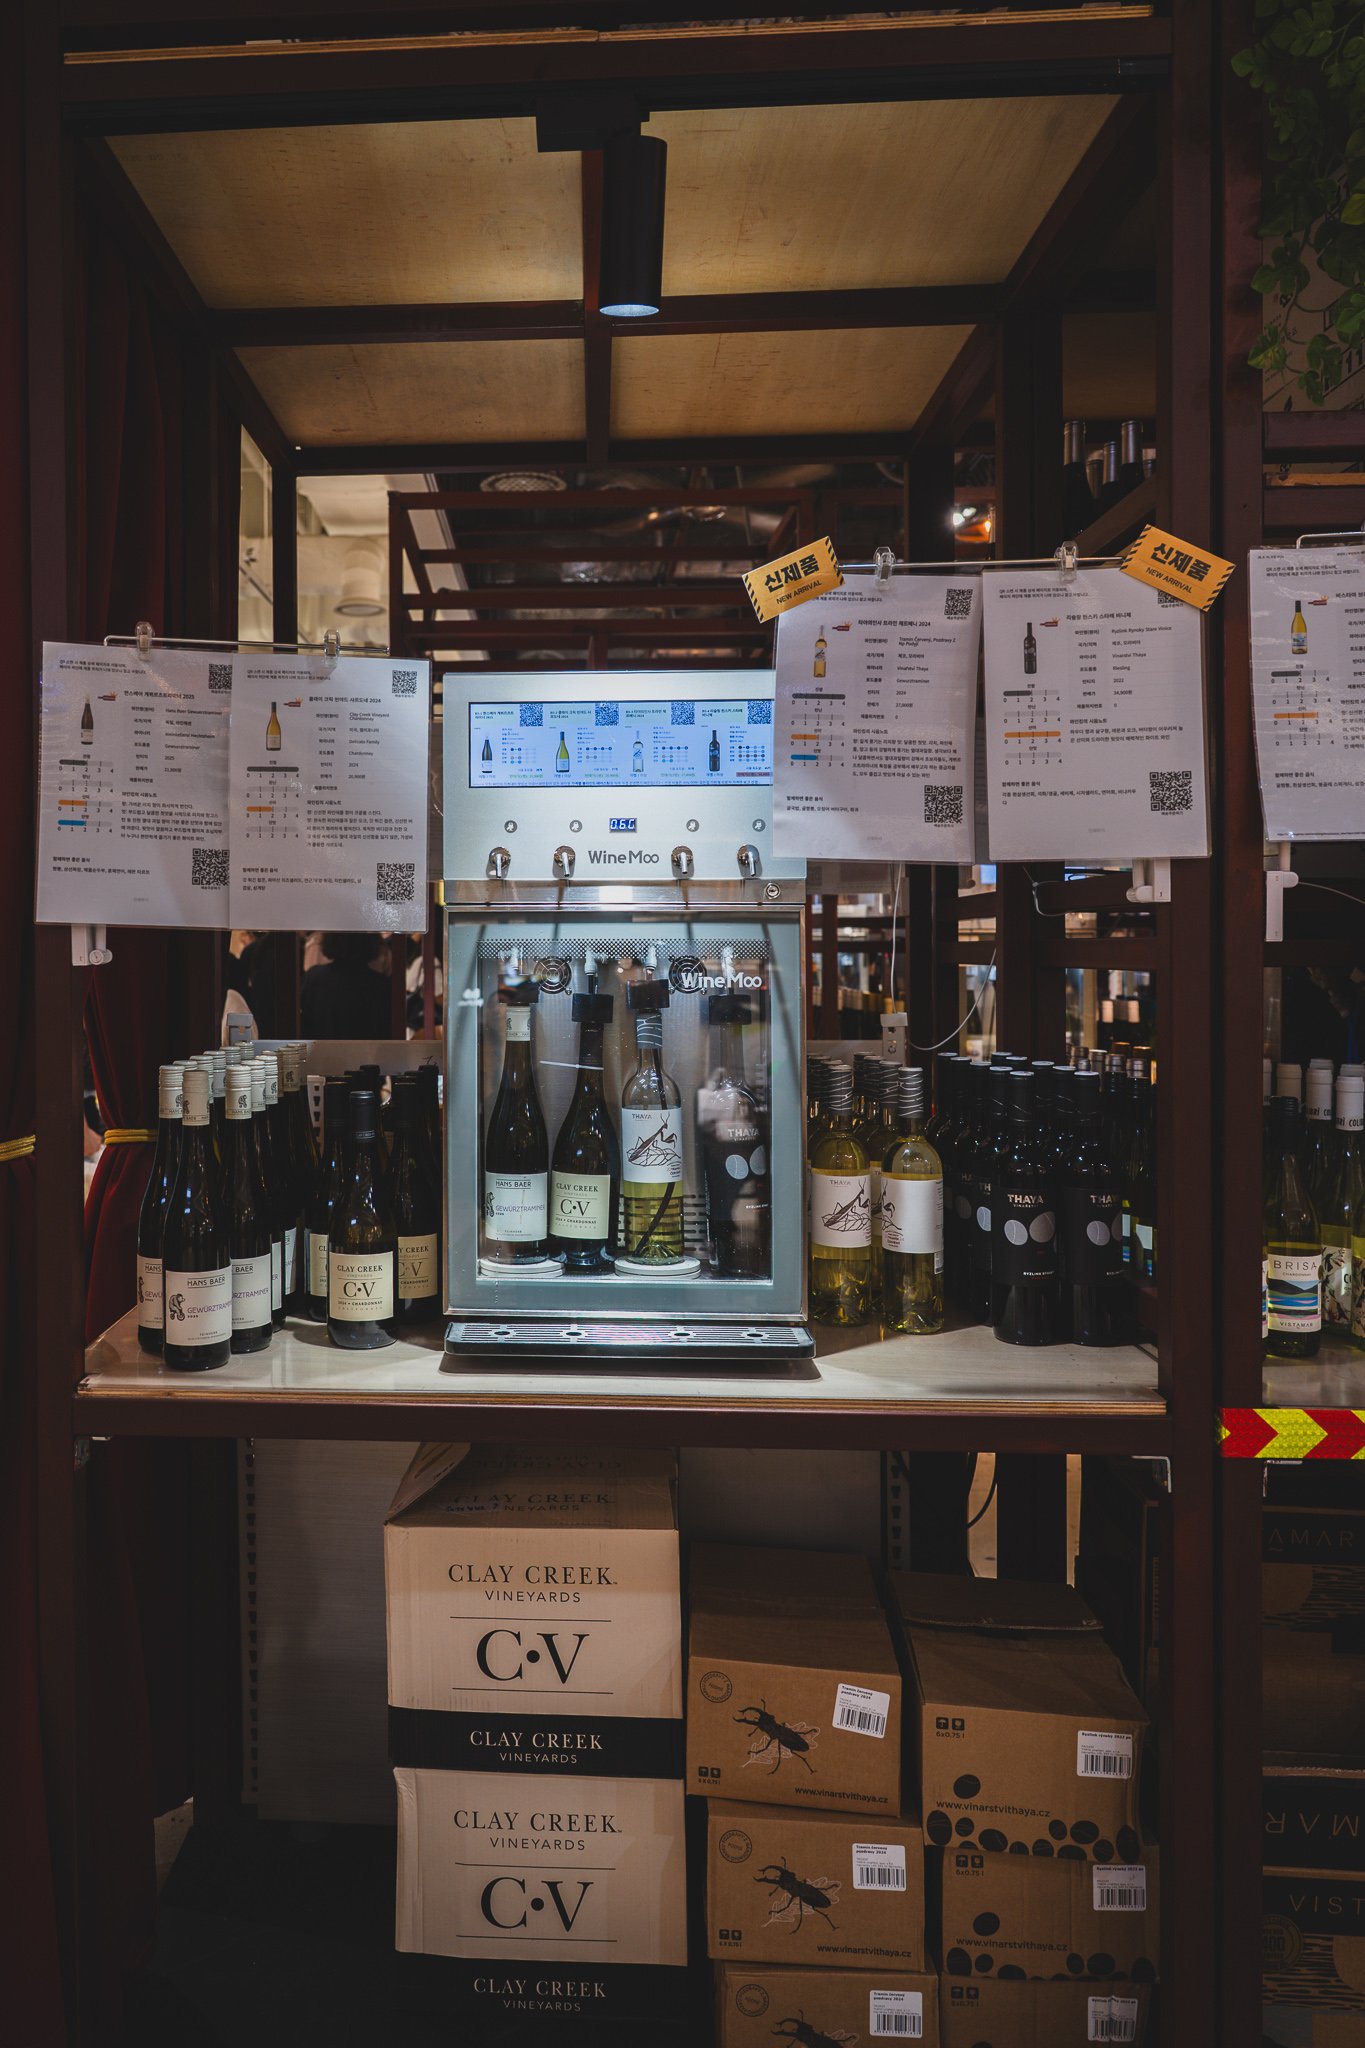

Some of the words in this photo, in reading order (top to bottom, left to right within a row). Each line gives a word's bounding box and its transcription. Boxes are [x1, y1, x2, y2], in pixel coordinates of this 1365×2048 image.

[1151, 543, 1212, 582] 신제품
[764, 554, 820, 592] 신제품
[1146, 567, 1164, 580] NEW
[1164, 574, 1193, 594] ARRIVAL
[776, 592, 793, 604] NEW
[792, 580, 823, 598] ARRIVAL
[728, 1128, 760, 1137] THAYA
[573, 1184, 599, 1192] CREEK
[1007, 1194, 1044, 1204] THAYA
[406, 1245, 429, 1253] CREEK
[337, 1265, 356, 1273] CLAY
[358, 1264, 383, 1273] CREEK
[1273, 1260, 1317, 1270] BRISA
[210, 1276, 226, 1285] BAER
[504, 1504, 580, 1512] NEYARDS
[448, 1563, 514, 1583] CLAY
[525, 1566, 613, 1586] CREEK
[485, 1590, 581, 1603] VINEYARDS
[470, 1731, 524, 1748] CLAY
[532, 1733, 603, 1750] CREEK
[499, 1752, 578, 1764] VINEYARDS
[795, 1785, 889, 1804] www.vinarstvithaya.cz
[936, 1800, 1051, 1818] www.vinarstvithaya.cz
[454, 1809, 519, 1830] CLAY
[530, 1813, 618, 1833] CREEK
[490, 1837, 586, 1851] VINEYARDS
[817, 1944, 912, 1958] www.vinarstvithaya.cz
[956, 1937, 1068, 1952] www.vinarstvithaya.cz
[473, 1978, 528, 1995] CLAY
[535, 1980, 607, 1998] CREEK
[503, 1999, 582, 2012] VINEYARDS
